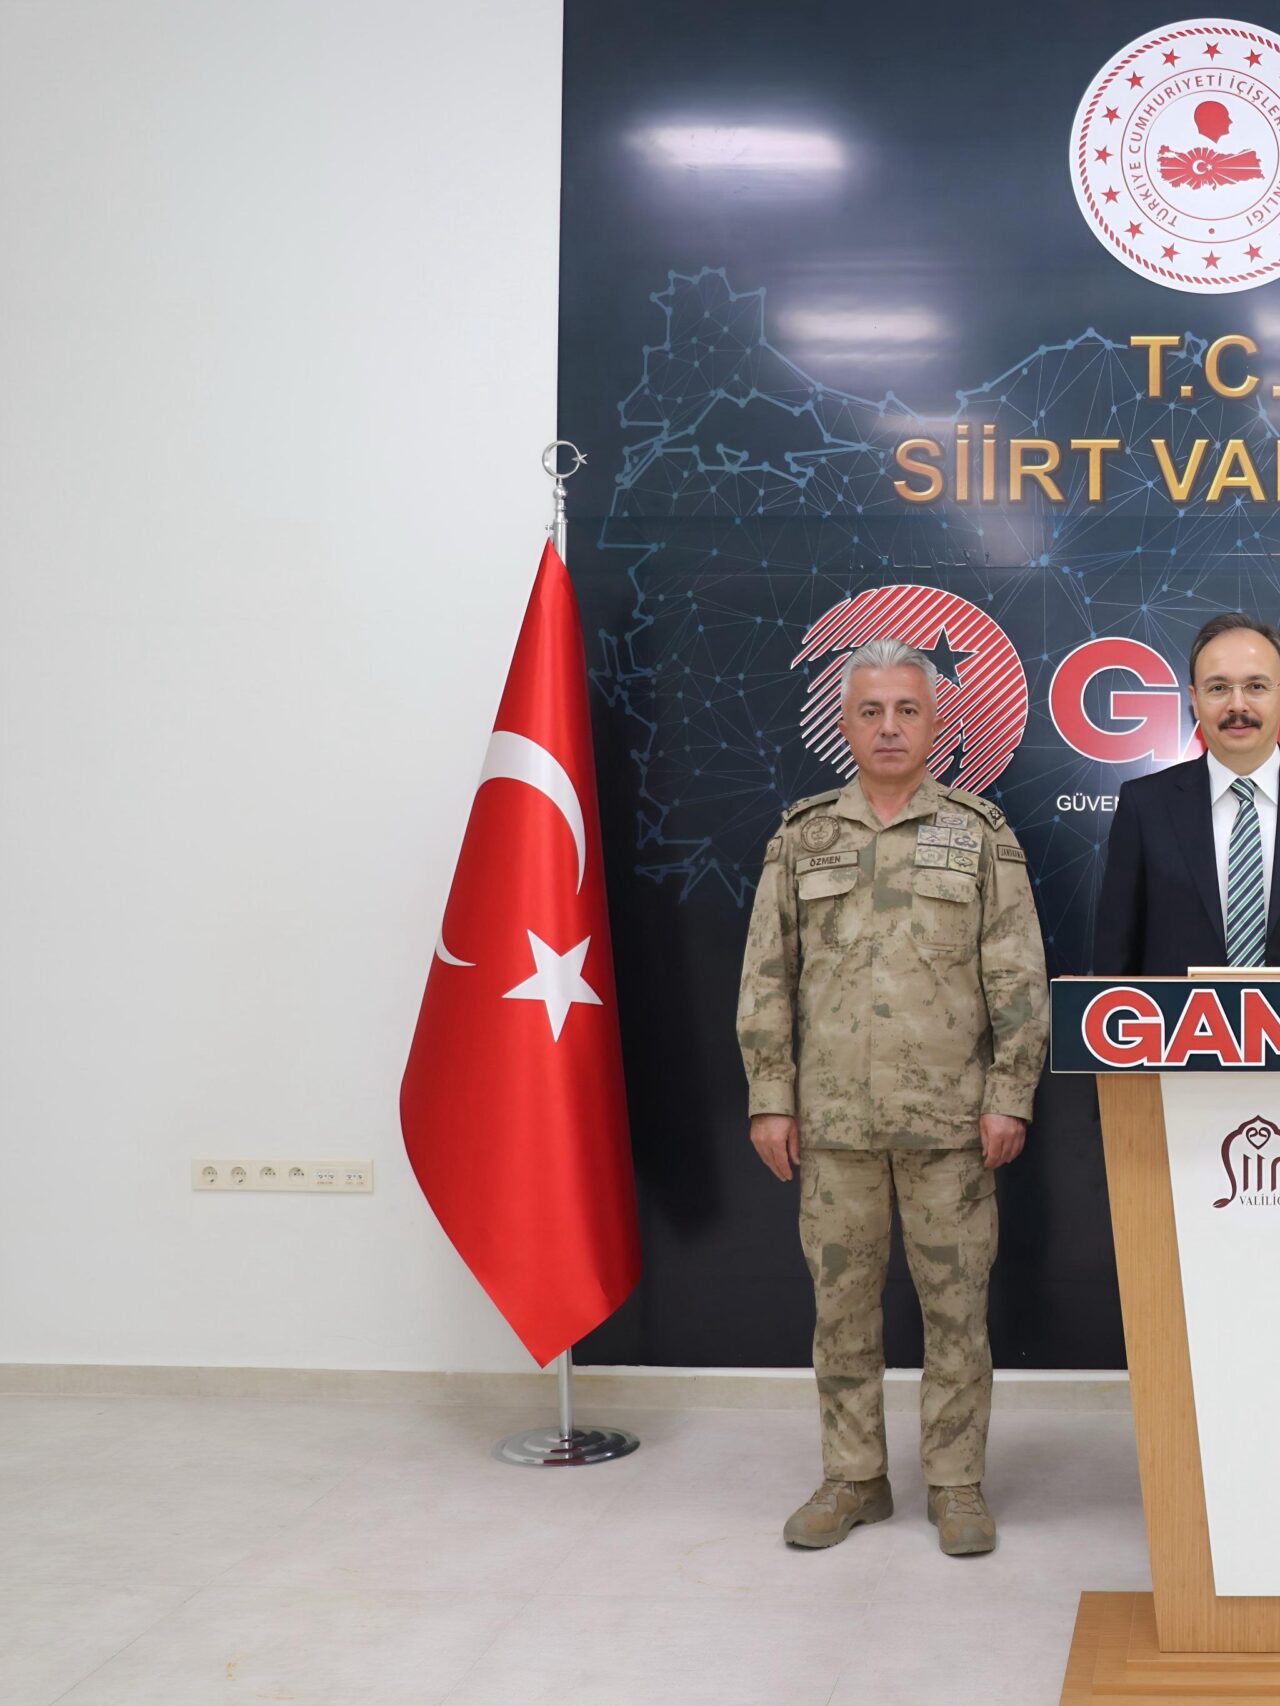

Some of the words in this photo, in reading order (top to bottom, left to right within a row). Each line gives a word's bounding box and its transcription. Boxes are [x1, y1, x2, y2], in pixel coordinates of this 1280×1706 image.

[1129, 73, 1222, 154] CUMHURİYETİ
[1129, 162, 1178, 228] TÜRKİYE
[893, 423, 1121, 502] SİİRT
[810, 855, 841, 867] ÖZMEN
